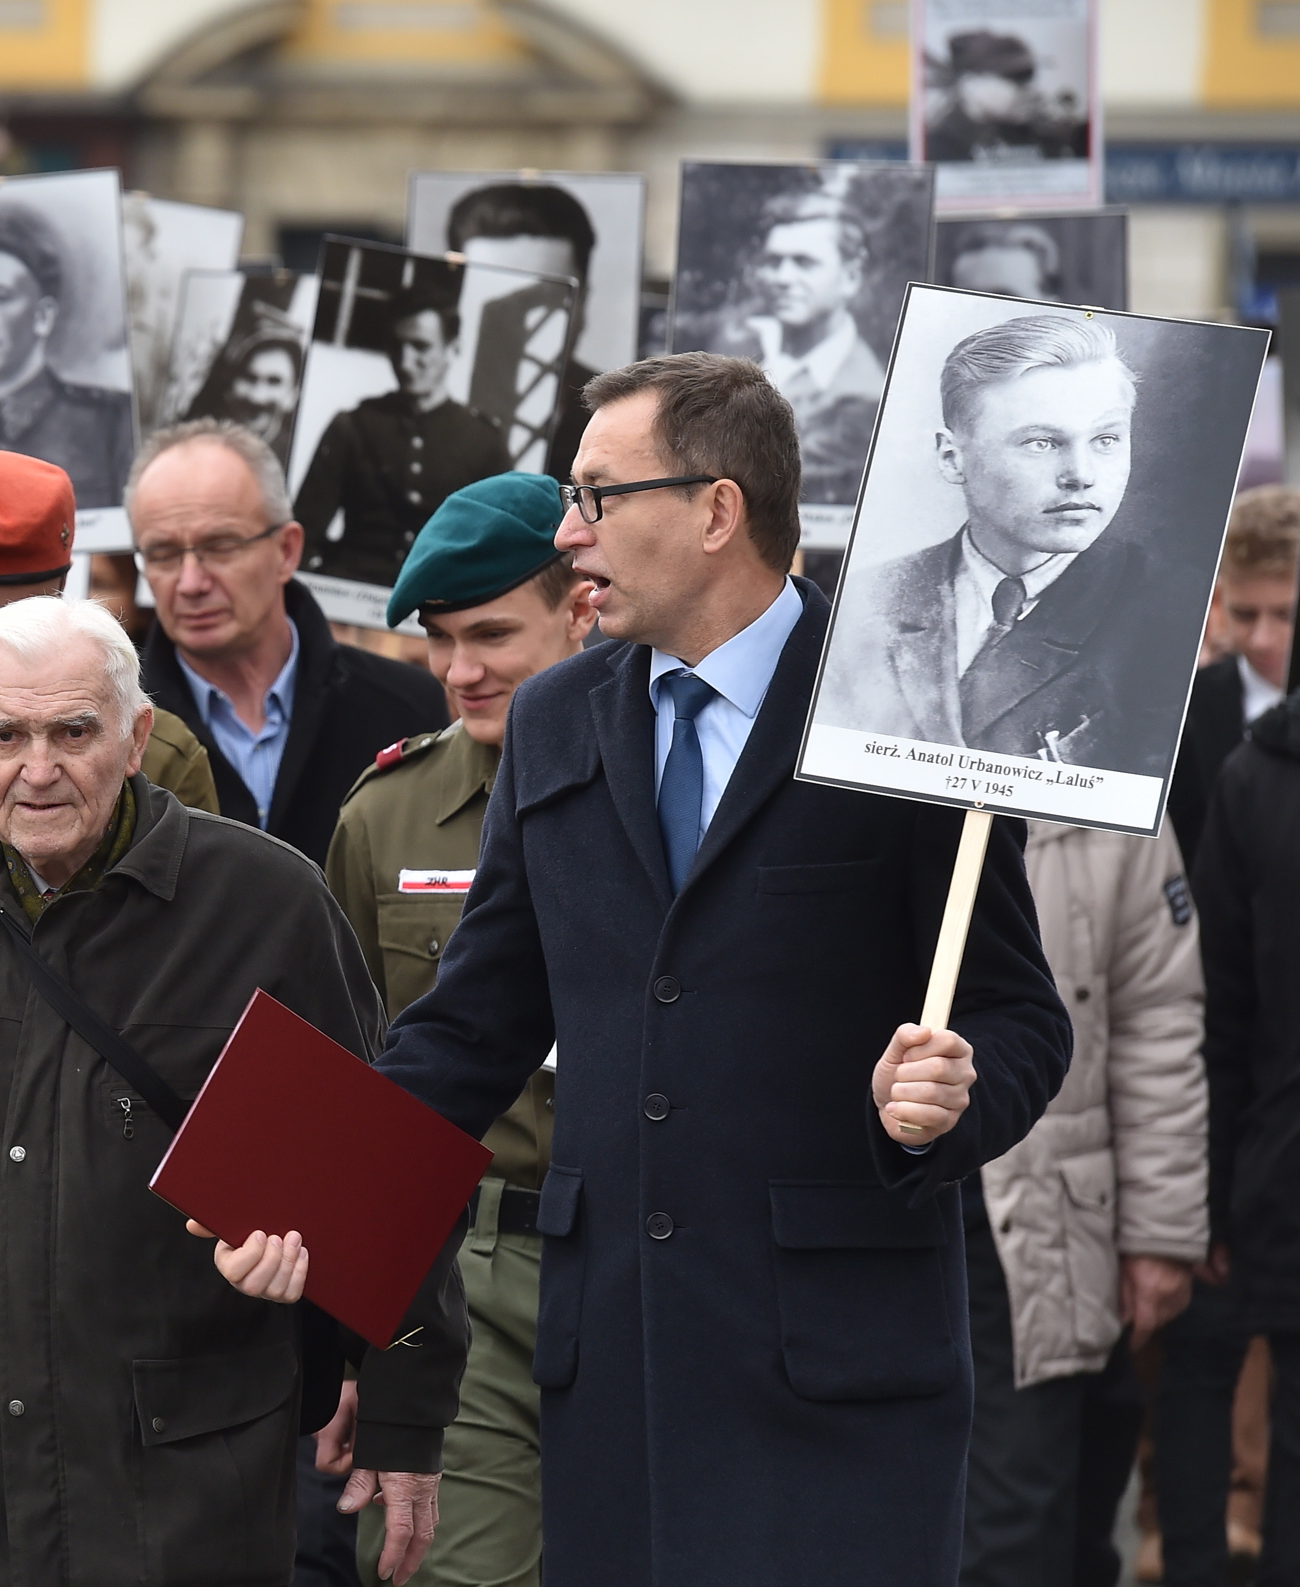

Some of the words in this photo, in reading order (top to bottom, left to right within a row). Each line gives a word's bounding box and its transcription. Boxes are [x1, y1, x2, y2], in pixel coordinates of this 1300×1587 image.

[864, 741, 901, 758] sierż.
[905, 747, 954, 767] Anatol
[958, 755, 1043, 781] Urbanowicz
[971, 779, 981, 791] V
[984, 782, 1014, 797] 1945
